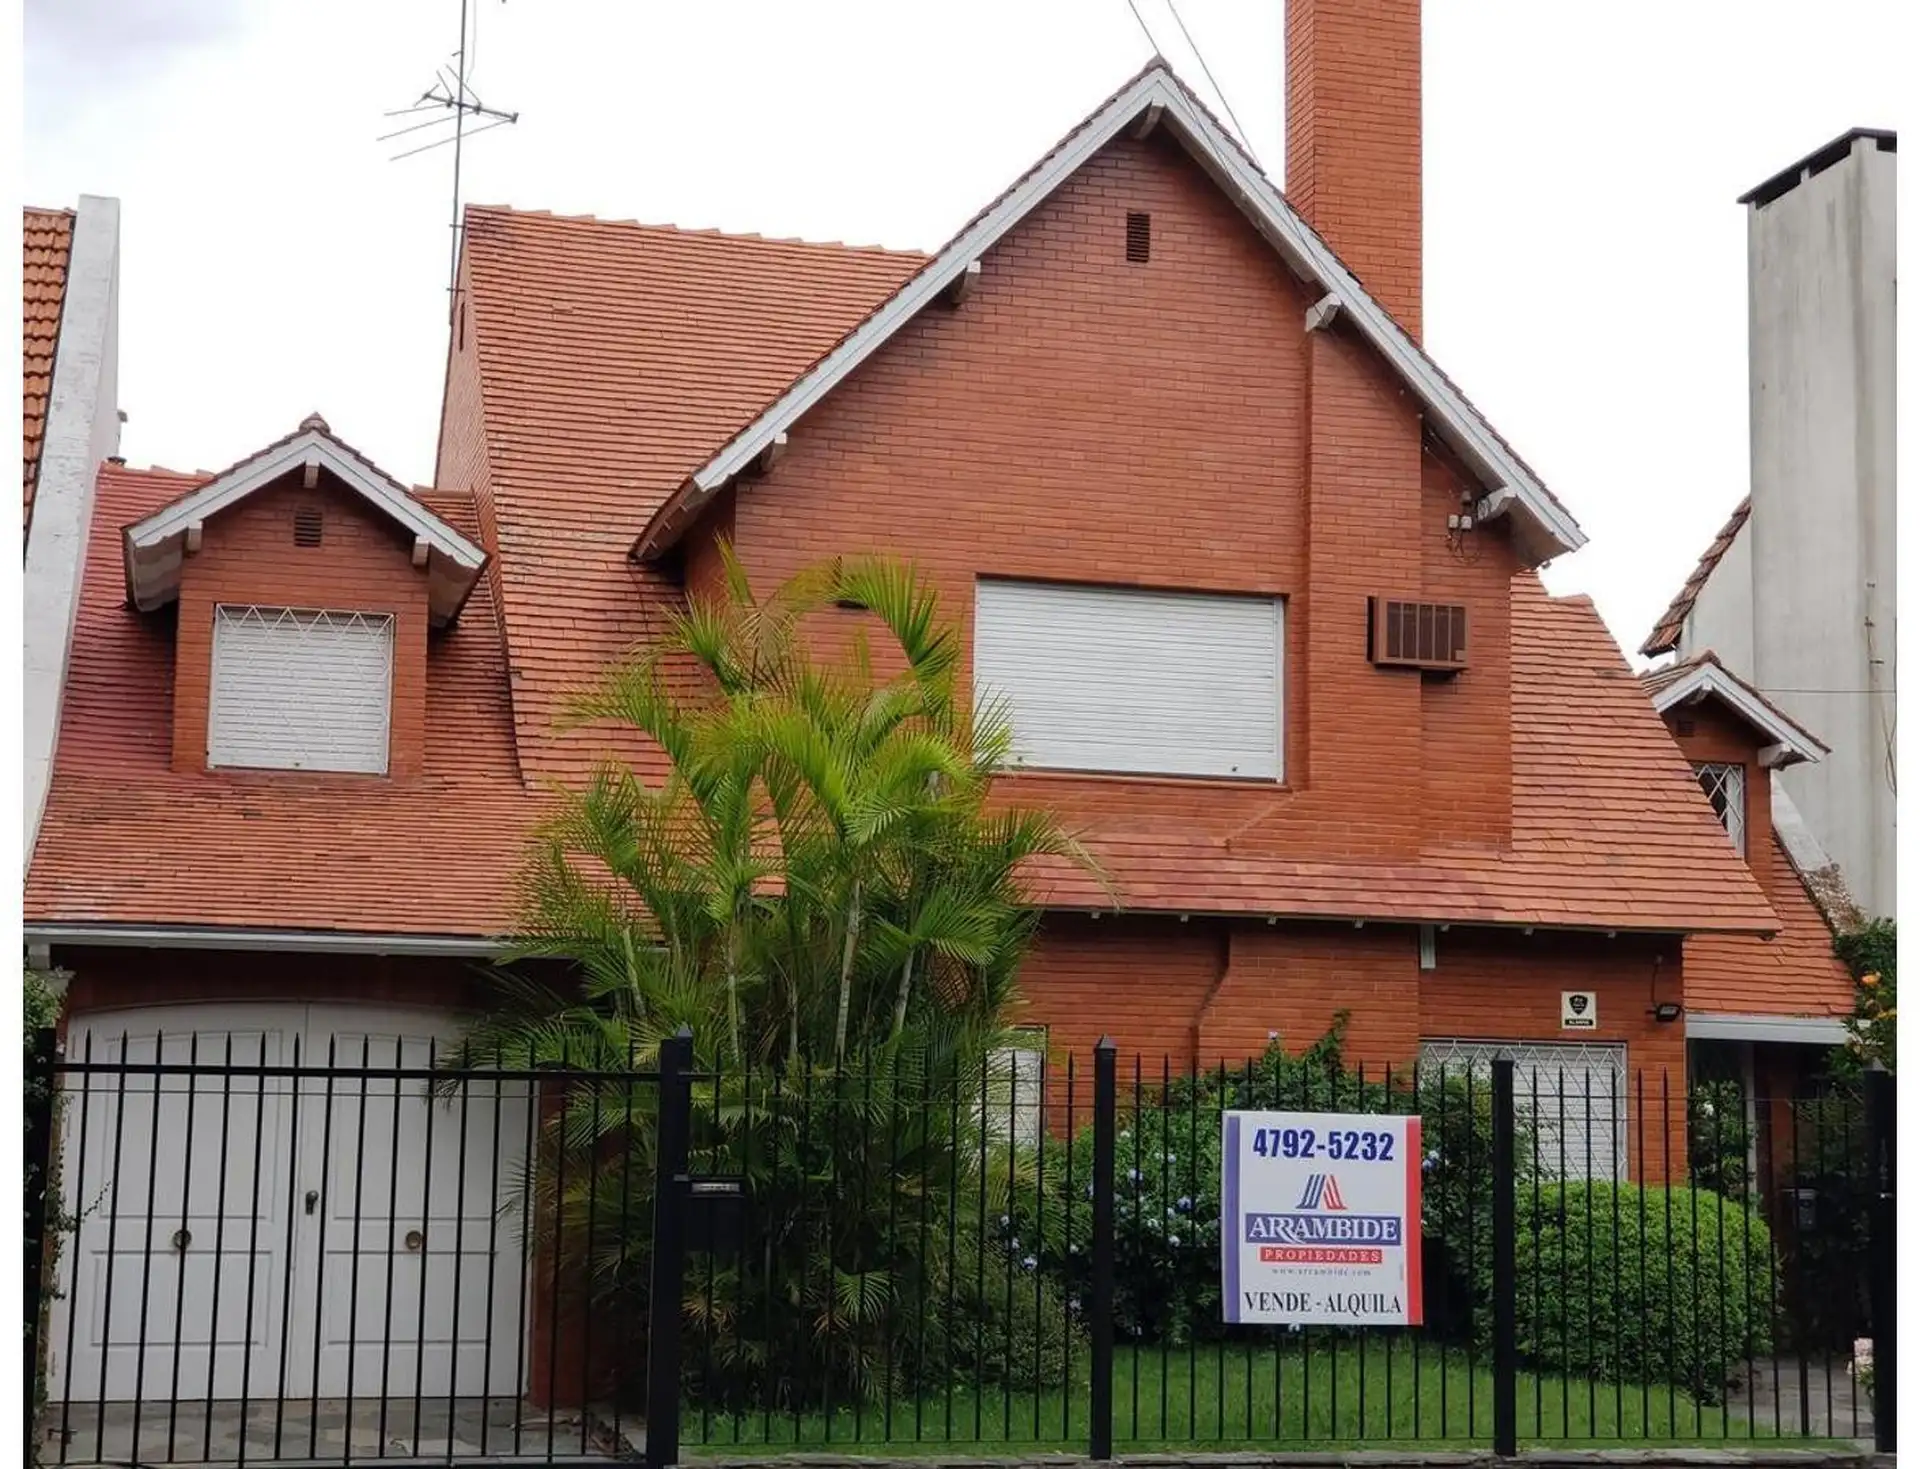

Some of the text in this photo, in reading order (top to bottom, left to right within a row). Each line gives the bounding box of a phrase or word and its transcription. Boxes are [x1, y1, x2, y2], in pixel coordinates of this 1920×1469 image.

[1253, 1128, 1394, 1161] 4792-5232
[1249, 1216, 1398, 1244] ARRAMBIDE
[1264, 1248, 1381, 1262] PROPIEDADES
[1245, 1292, 1311, 1313] VENDE
[1324, 1293, 1401, 1317] ALQUILA
